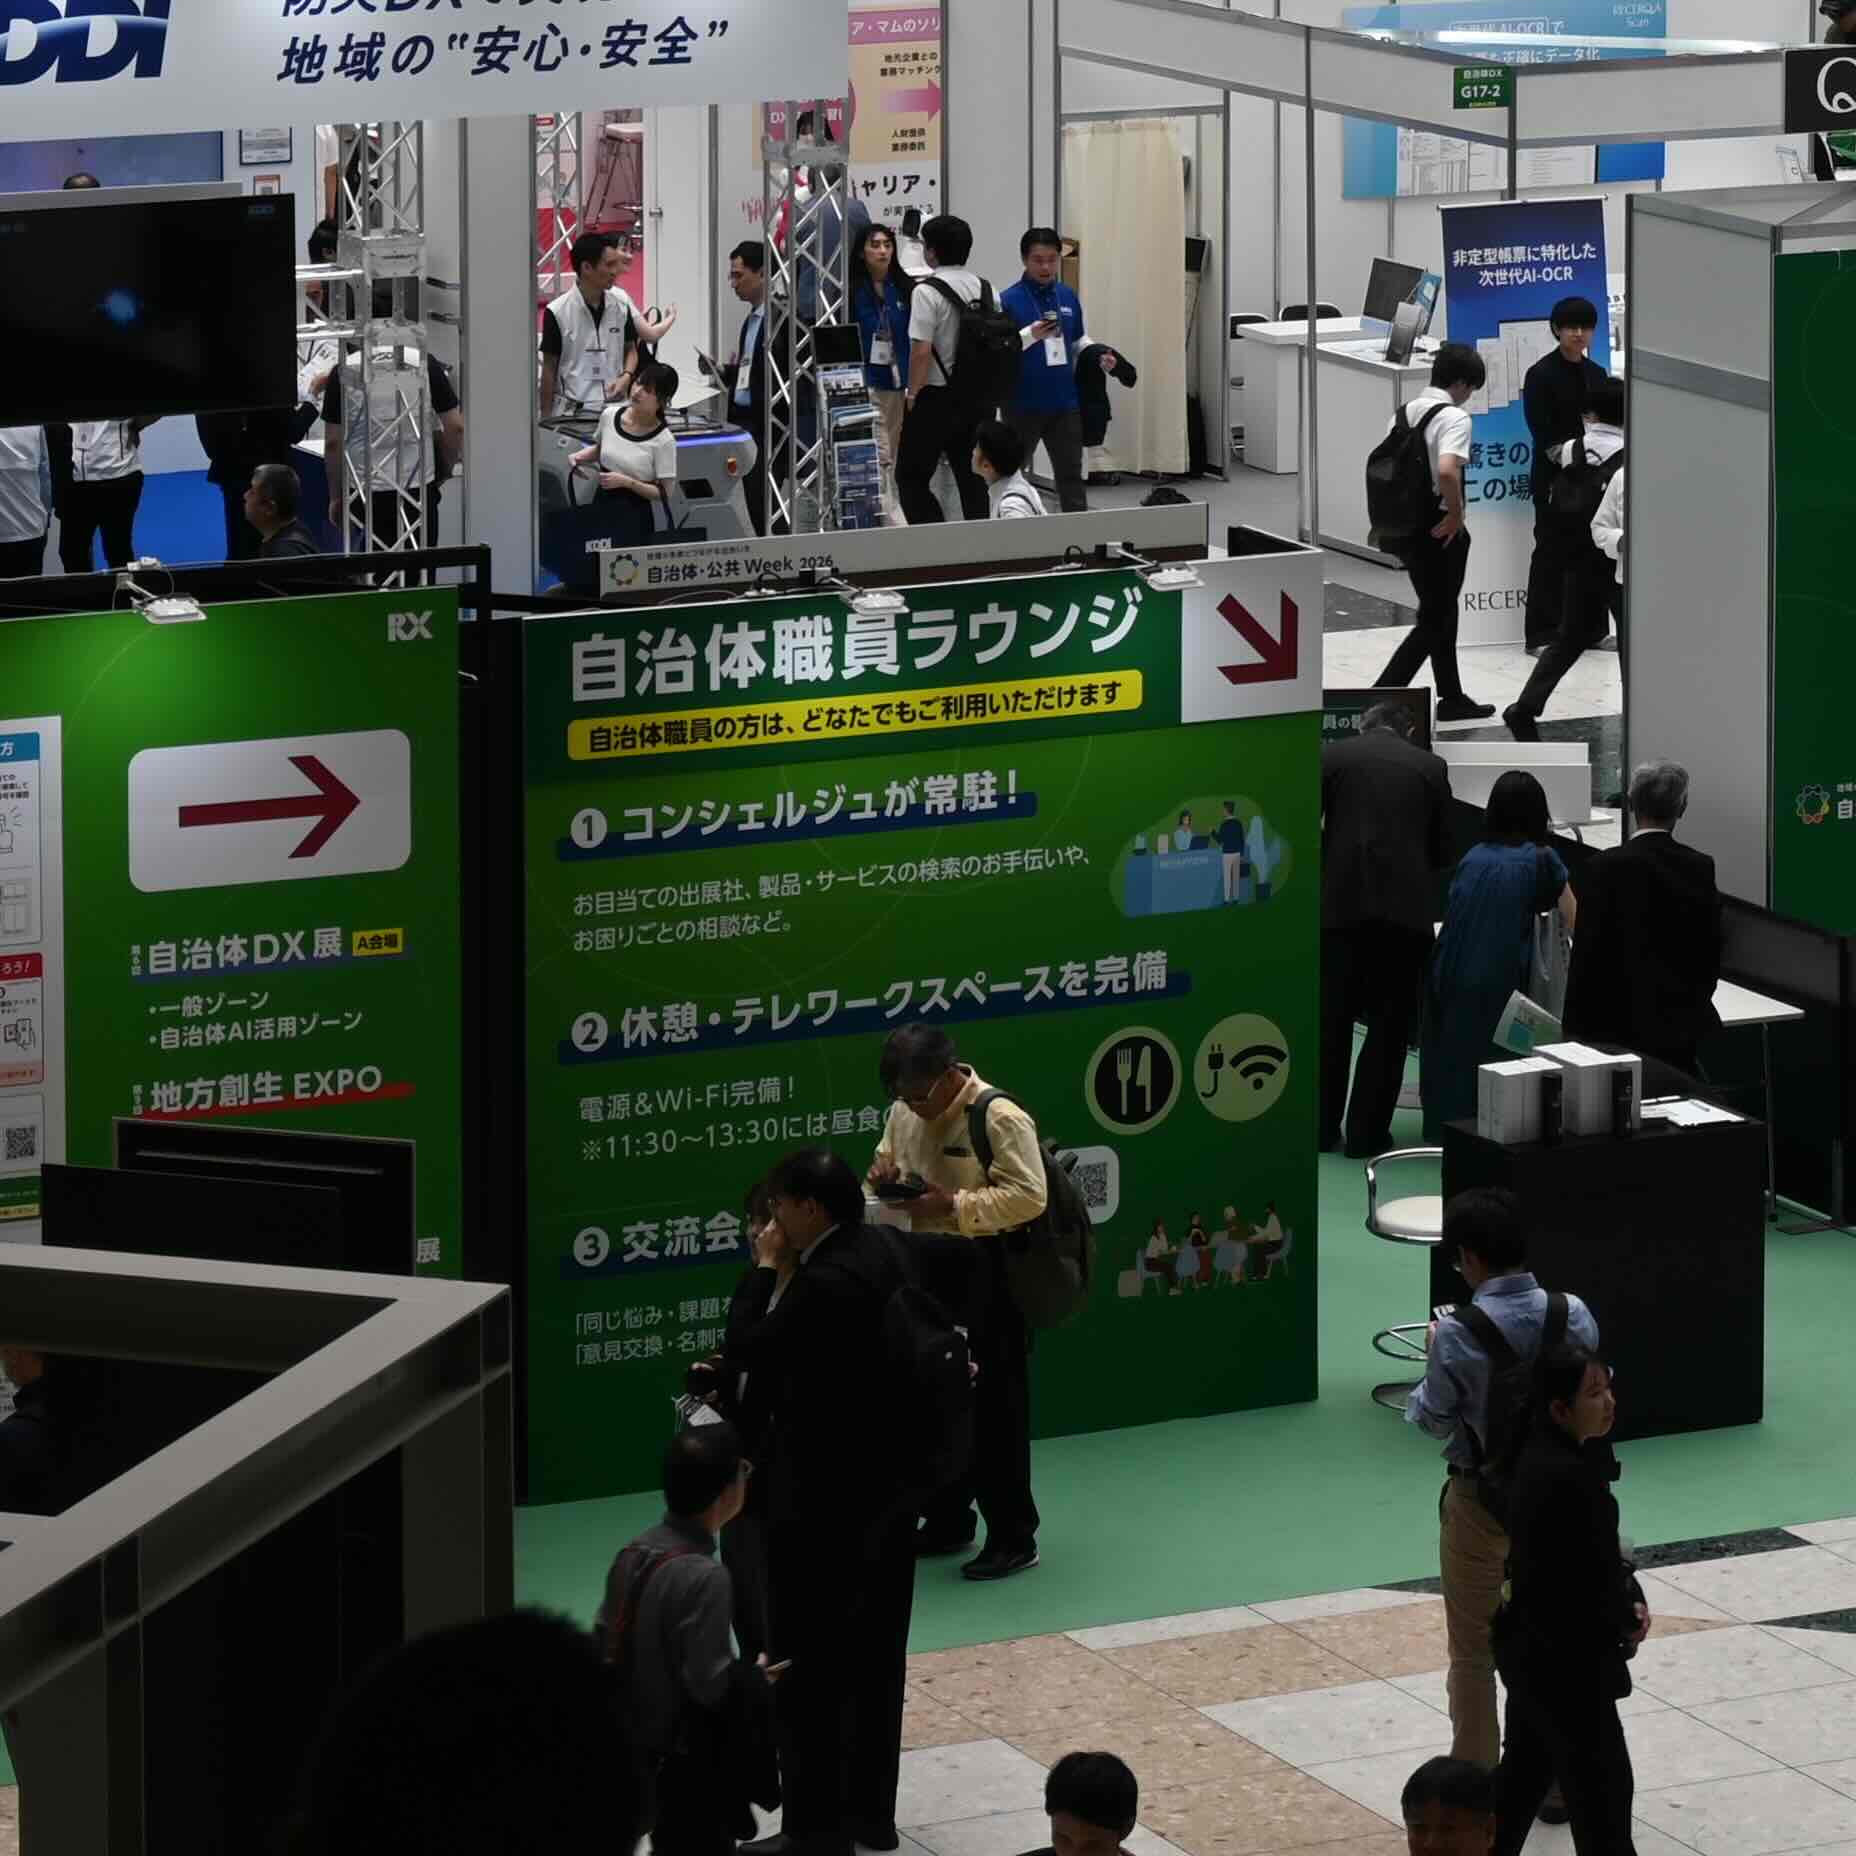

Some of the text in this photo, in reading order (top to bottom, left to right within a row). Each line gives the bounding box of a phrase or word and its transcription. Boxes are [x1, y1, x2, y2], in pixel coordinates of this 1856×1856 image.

[1460, 85, 1501, 99] G17-2
[1452, 242, 1597, 267] 非定型帳票に特化した
[1478, 266, 1574, 287] 次世代AI-OCR
[647, 554, 834, 584] 自治体・公共 Week 2026
[386, 610, 435, 642] RX
[572, 586, 1144, 703] 自治体職員ラウンジ
[589, 680, 1122, 754] 自治体職員の方は、どなたでもご利用いただけます
[622, 768, 1022, 843] コンシェルジュが常駐！
[572, 846, 1092, 917] お目当ての出展社、製品・サービスの検索のお手伝いや、
[148, 927, 343, 975] 自治体DX展
[572, 910, 794, 954] お困りごとの相談など。
[621, 951, 1169, 1048] 休憩・テレワークスペースを完備
[149, 1064, 383, 1115] 地方創生 EXPO
[622, 1209, 741, 1261] 交流会
